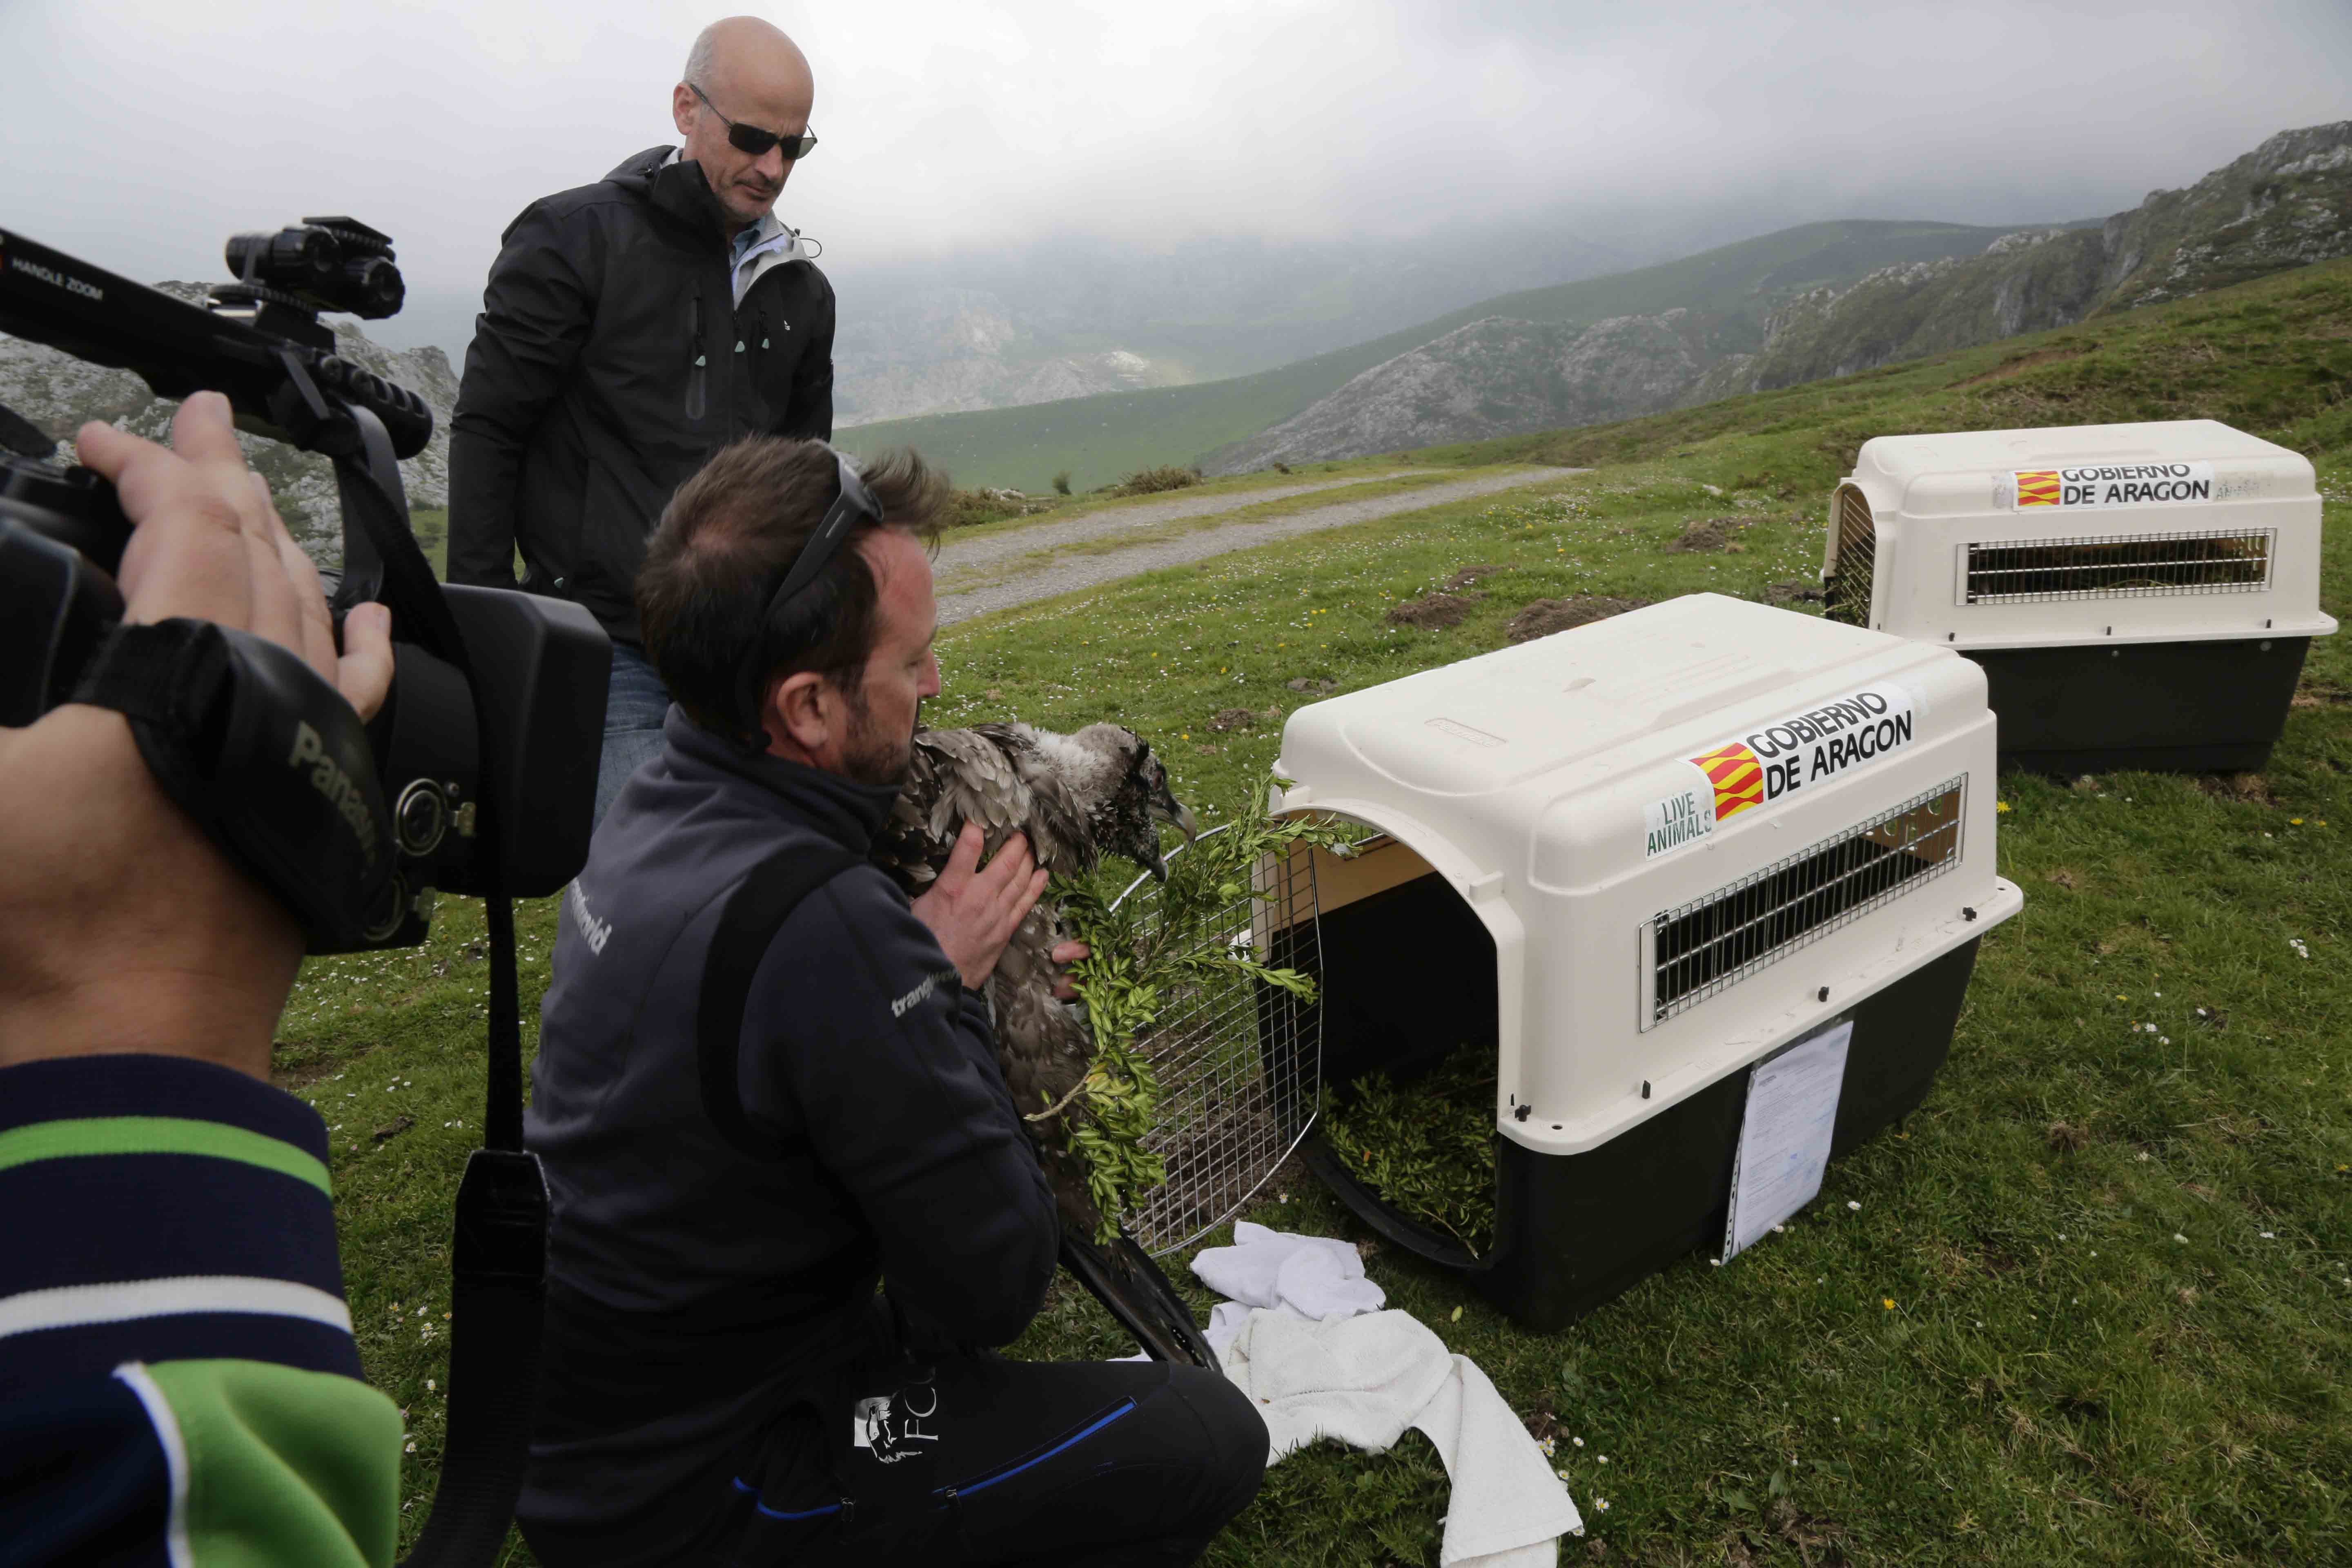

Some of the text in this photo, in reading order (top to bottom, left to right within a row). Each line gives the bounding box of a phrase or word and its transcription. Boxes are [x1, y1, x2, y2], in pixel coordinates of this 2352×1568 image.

[11, 257, 103, 301] HANDLE ZOOM
[2062, 464, 2191, 482] GOBIERNO
[2063, 484, 2096, 506] DE
[2104, 480, 2210, 503] ARAGON
[1746, 693, 1887, 758] GOBIERNO
[1766, 710, 1912, 800] DE ARAGON
[1662, 791, 1695, 825] LIVE
[1647, 809, 1712, 857] ANIMALS
